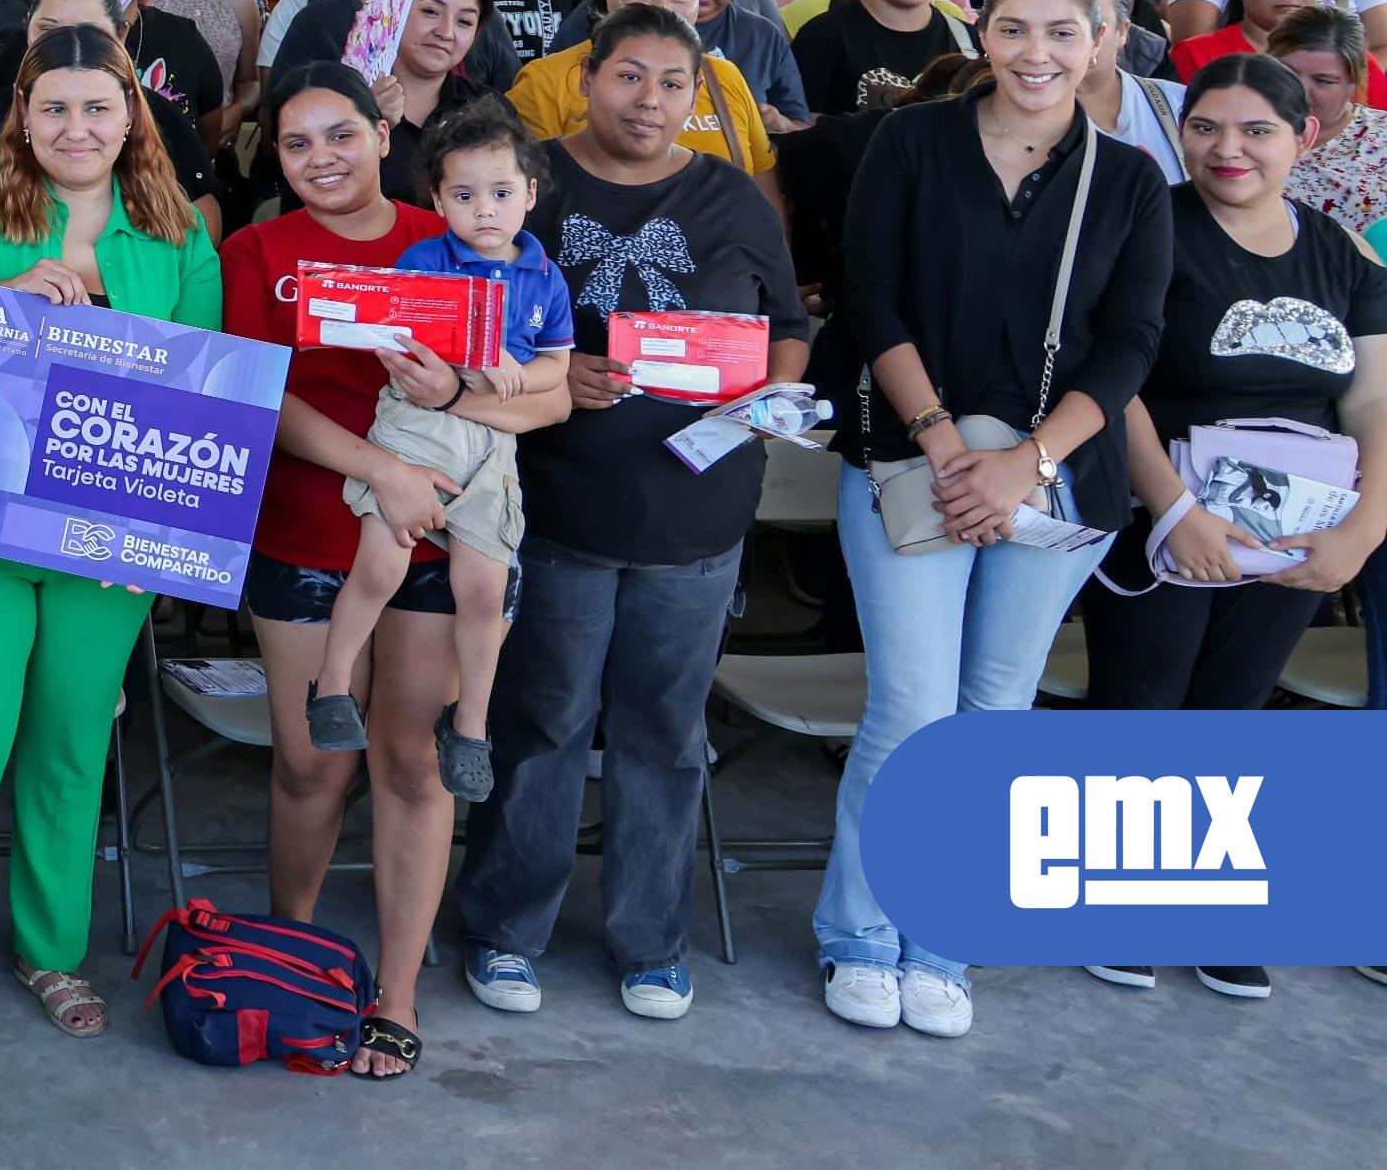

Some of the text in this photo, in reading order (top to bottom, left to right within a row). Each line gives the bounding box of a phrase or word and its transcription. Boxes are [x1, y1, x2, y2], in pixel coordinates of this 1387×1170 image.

[337, 282, 390, 293] BANORTE
[48, 326, 170, 366] BIENESTAR
[648, 323, 700, 334] BANORTE
[45, 344, 165, 376] Secretaría de Bienestar
[55, 390, 135, 424] CON EL
[50, 409, 251, 477] CORAZÓN
[43, 457, 201, 509] Tarjeta Violeta
[45, 436, 245, 496] POR LAS MUJERES
[120, 547, 232, 585] COMPARTIDO
[123, 534, 209, 566] BIENESTAR
